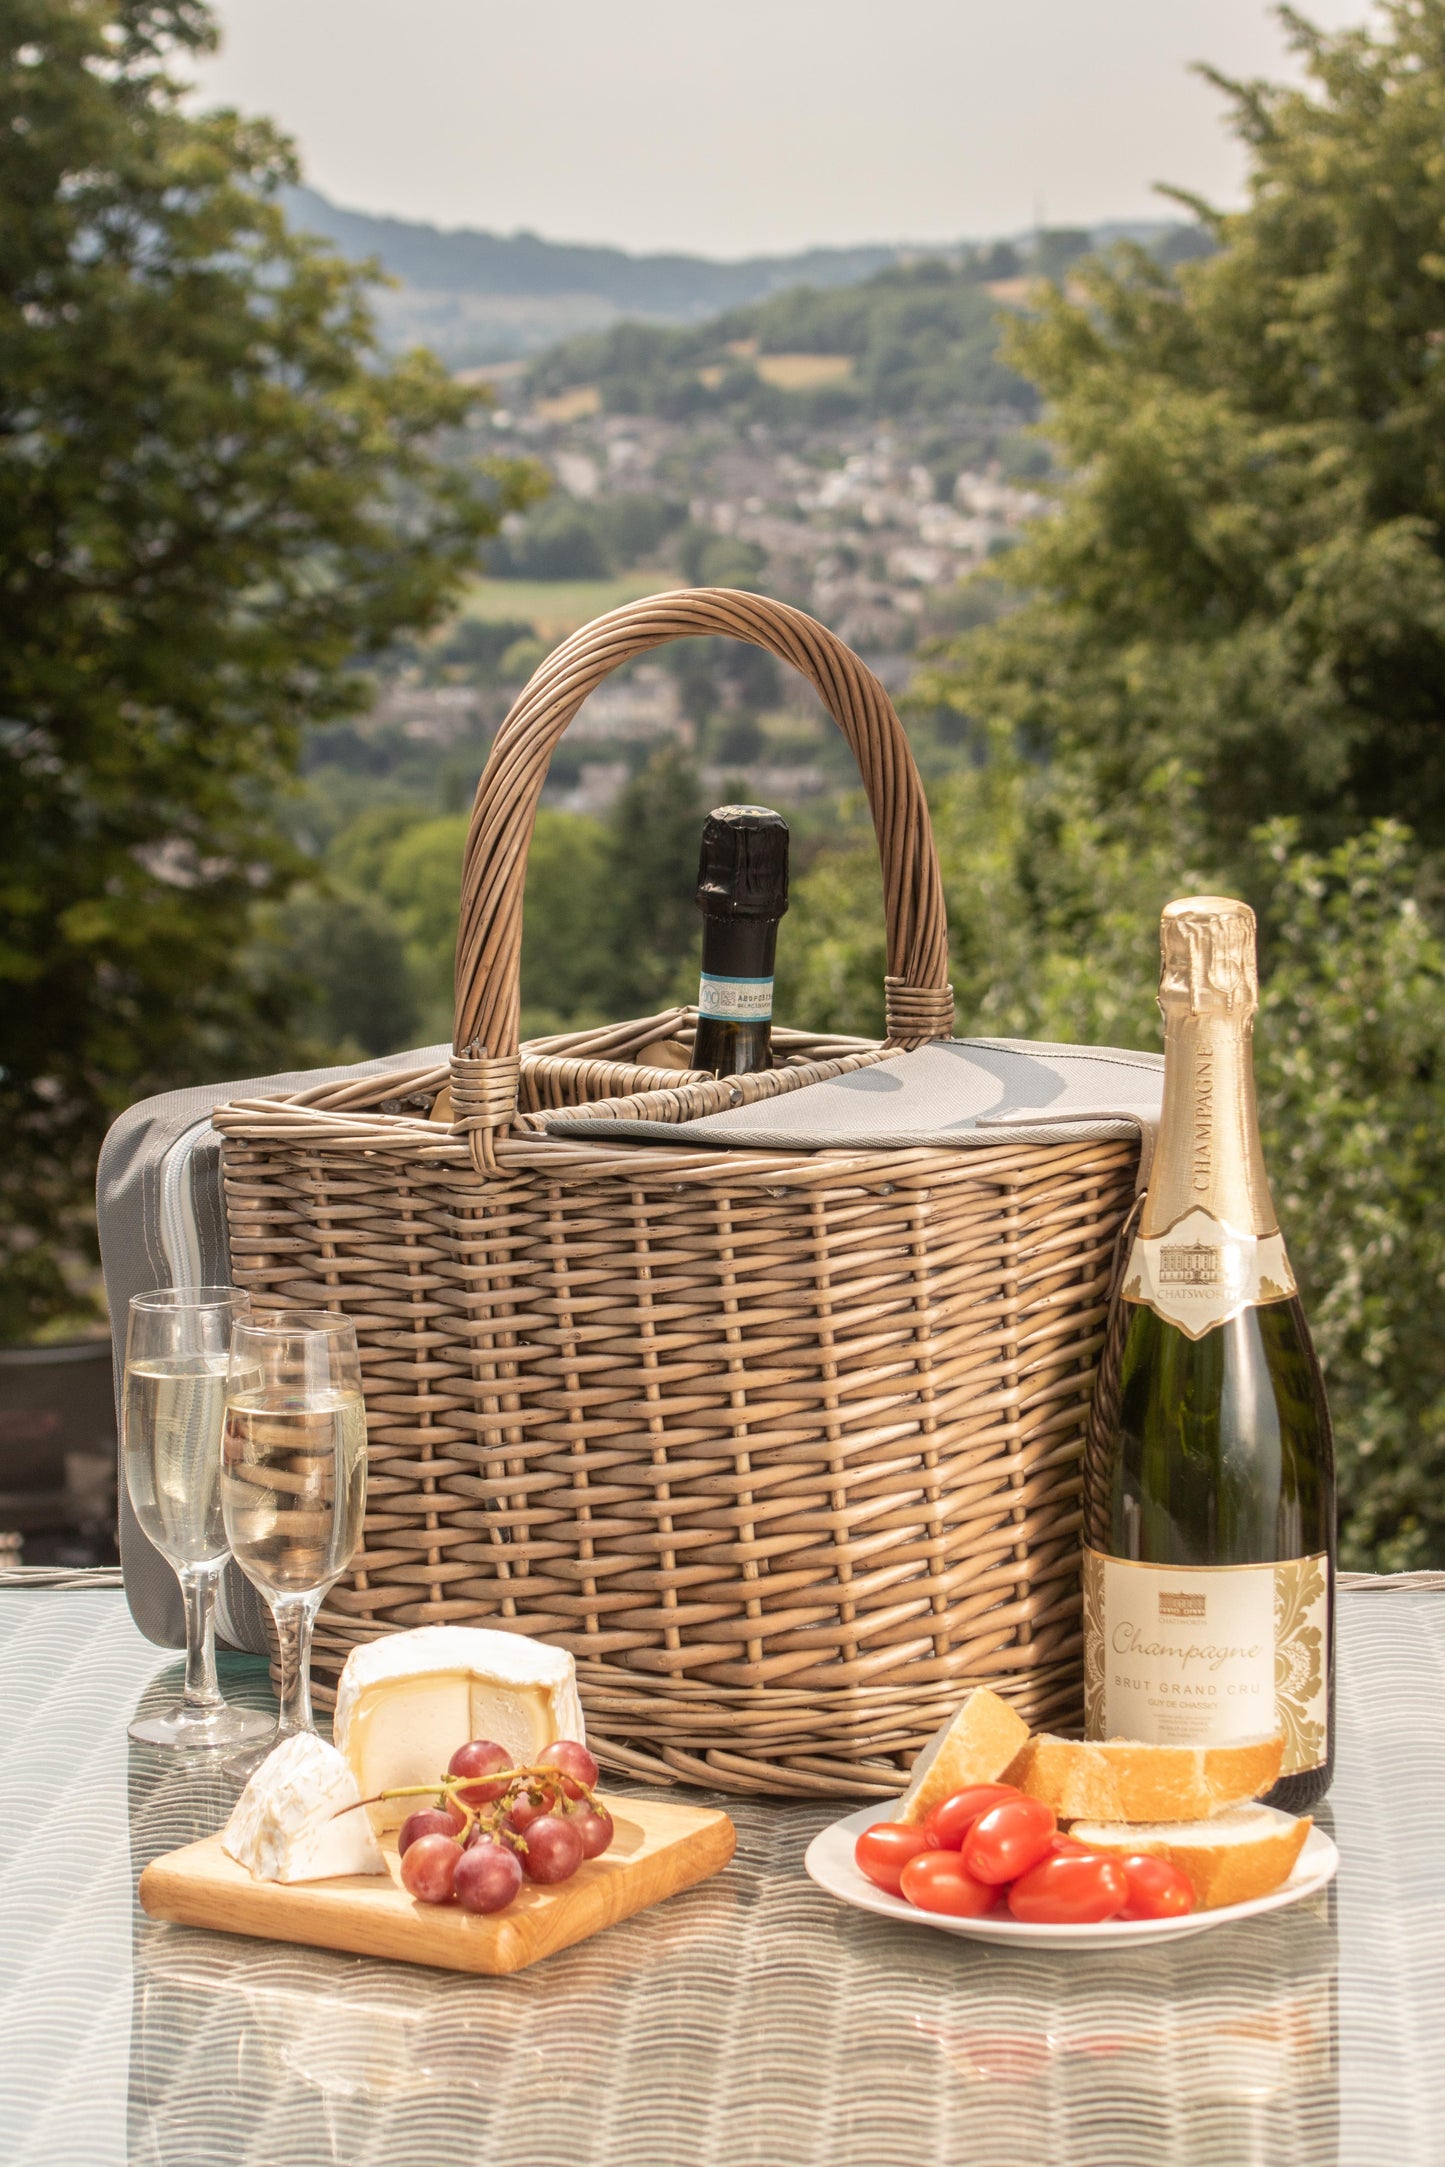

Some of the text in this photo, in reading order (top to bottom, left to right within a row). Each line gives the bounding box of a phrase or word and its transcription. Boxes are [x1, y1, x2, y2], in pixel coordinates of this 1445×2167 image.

[1194, 1044, 1214, 1192] CHAMPAGNE
[1157, 1288, 1238, 1300] CHATSWO
[1112, 1621, 1263, 1671] Champagne
[1115, 1675, 1261, 1696] BRUT GRAND CRU
